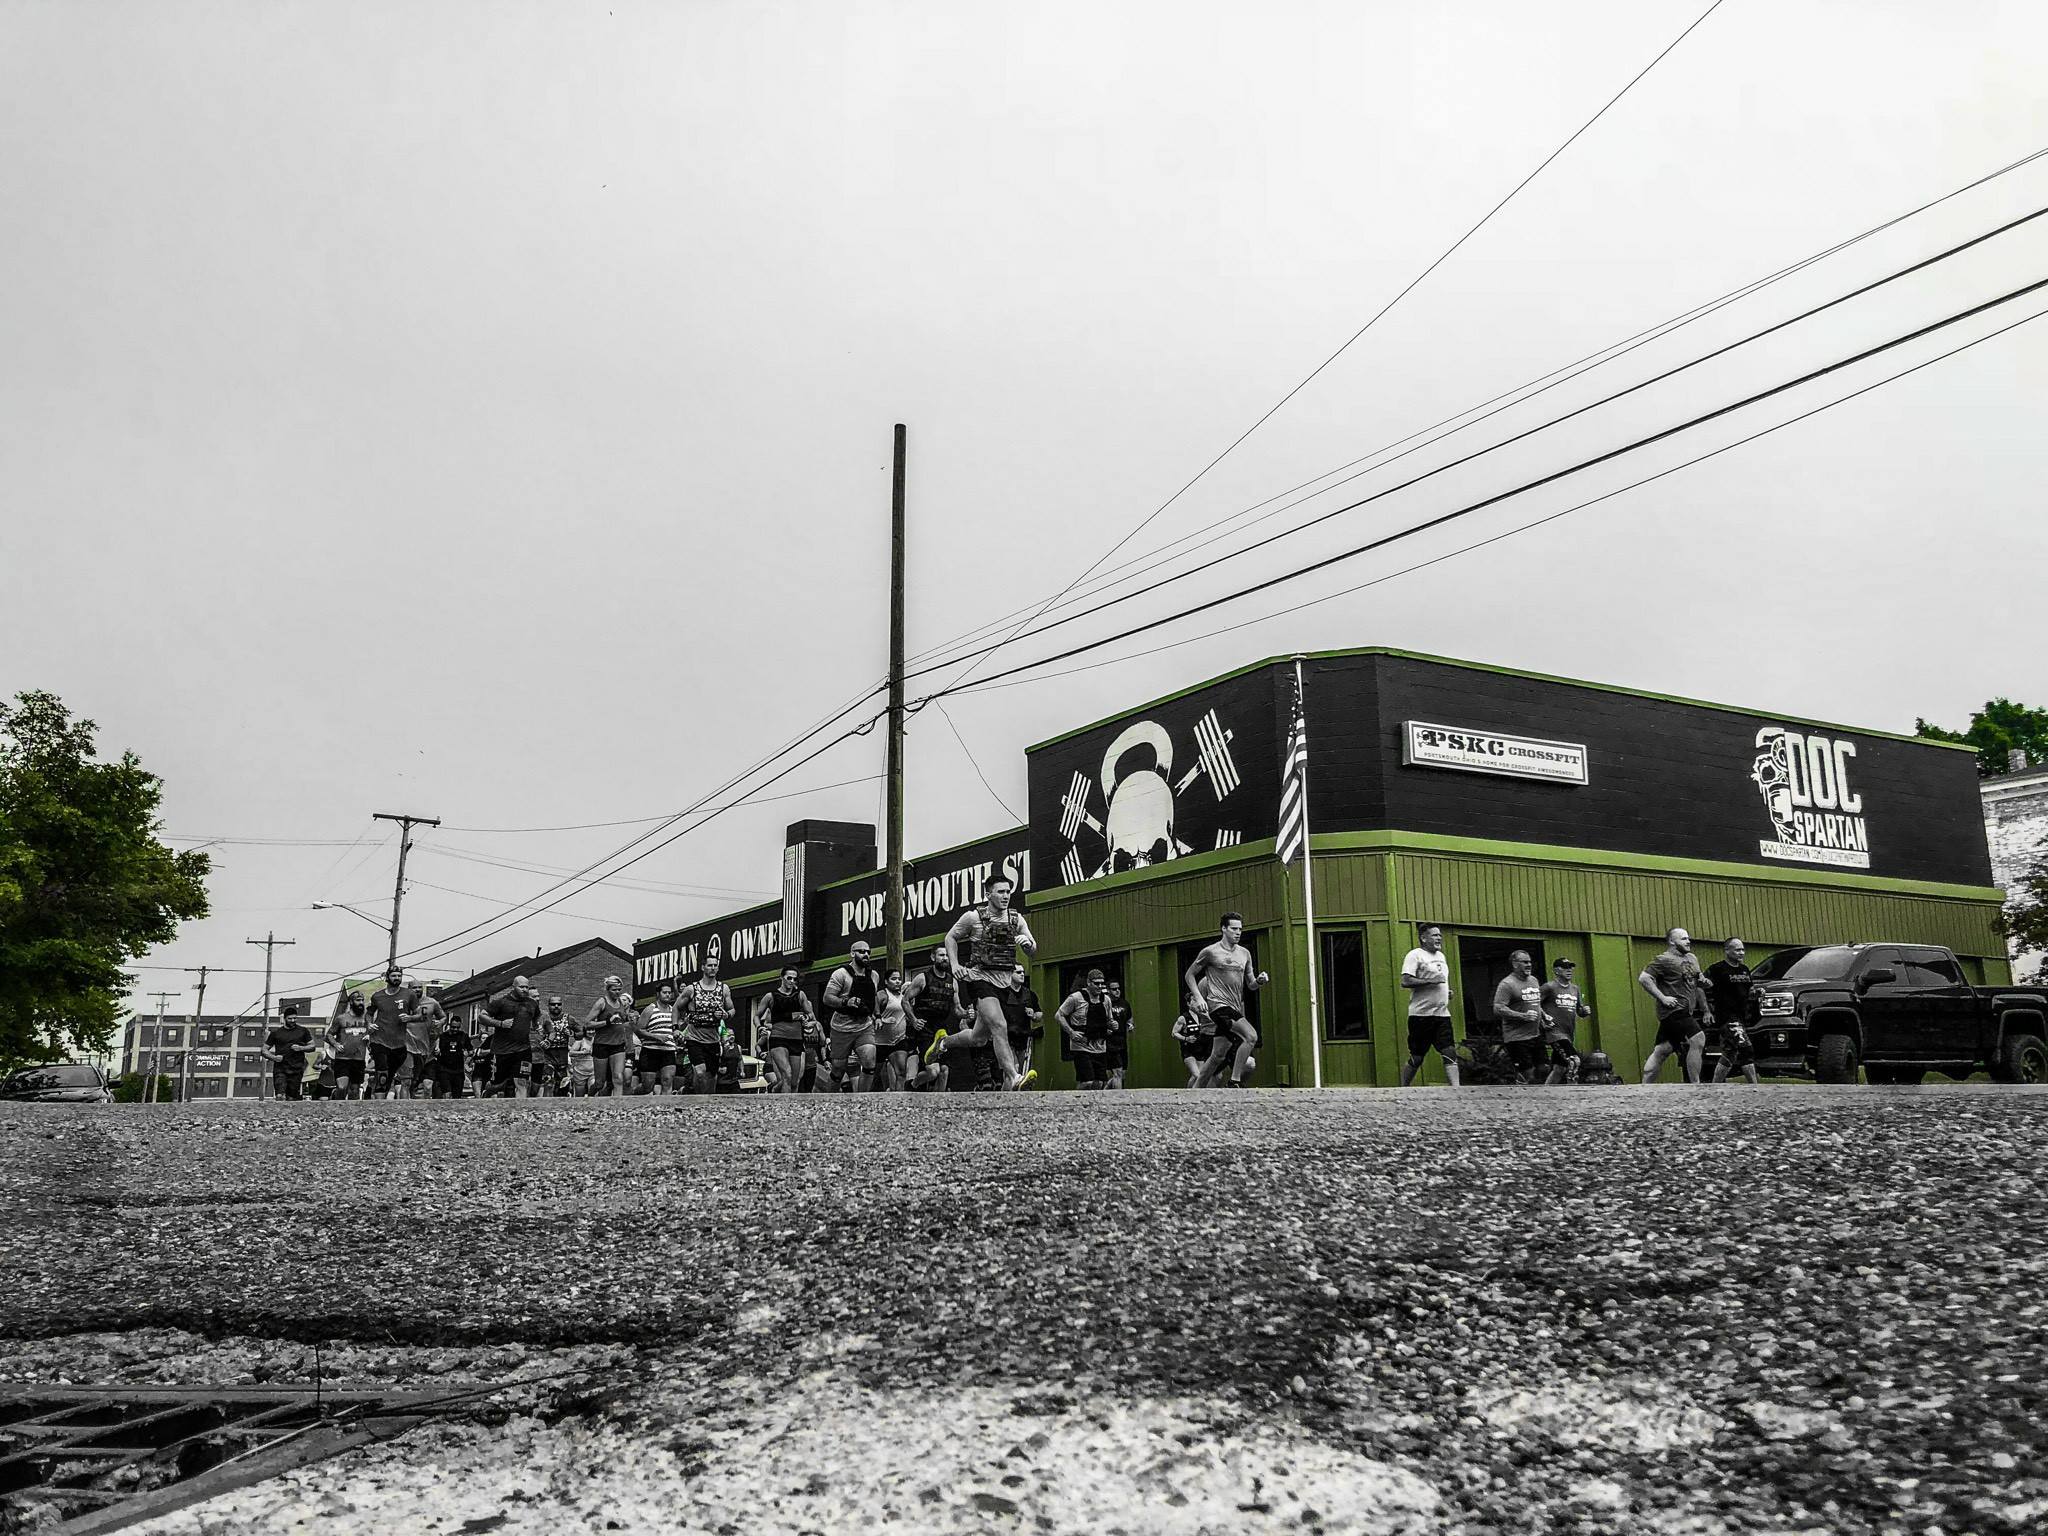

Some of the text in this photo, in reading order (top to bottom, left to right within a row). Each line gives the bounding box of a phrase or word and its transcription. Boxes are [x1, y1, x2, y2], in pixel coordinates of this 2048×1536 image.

[1428, 730, 1580, 764] PSKC CROSSFIT
[1784, 731, 1862, 813] DOC
[1793, 810, 1869, 851] SPARTAN
[841, 861, 994, 936] PORMOUTH
[636, 942, 700, 985] VETERAN
